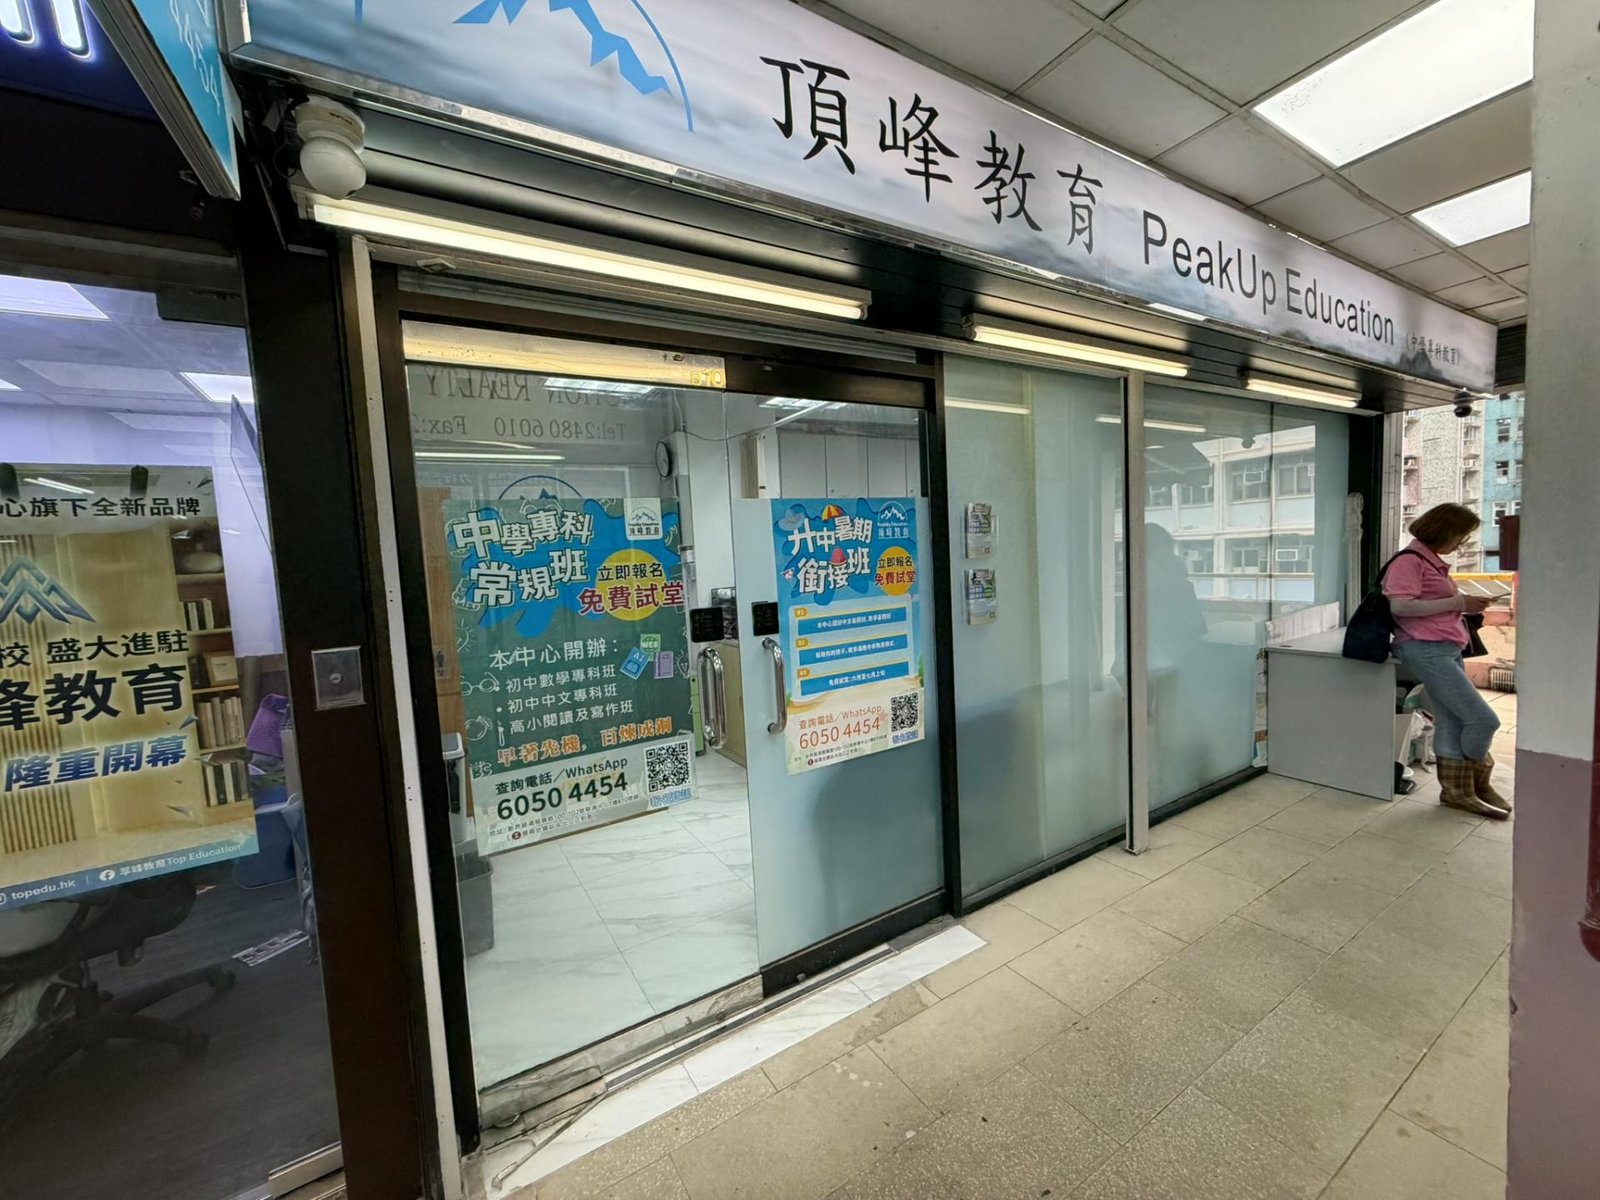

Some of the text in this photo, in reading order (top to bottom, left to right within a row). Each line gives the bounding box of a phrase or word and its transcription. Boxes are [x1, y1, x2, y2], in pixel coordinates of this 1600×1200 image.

[759, 56, 1104, 255] 頂峰教育
[1143, 210, 1395, 346] PeakUp Education
[0, 497, 201, 517] 心旗下全新品牌
[452, 509, 593, 559] 中學專科
[788, 515, 873, 556] 升中暑期
[469, 549, 591, 607] 常規班
[598, 561, 664, 582] 立即報名
[797, 547, 871, 594] 銜接班
[875, 571, 917, 586] 免費試堂
[878, 555, 914, 569] 立即報名
[577, 581, 684, 616] 免費試堂
[47, 629, 190, 664] 盛大進駐
[505, 664, 616, 694] 初中數學專科班
[507, 683, 618, 714] 初中中文專科班
[509, 700, 634, 735] 高小閱讀及寫作班
[799, 726, 840, 749] 6050
[843, 717, 881, 740] 4454
[4, 735, 188, 792] 隆重開幕
[497, 787, 562, 820] 6050
[568, 772, 628, 802] 4454
[189, 844, 242, 861] Education
[11, 879, 76, 900] topedu.hk
